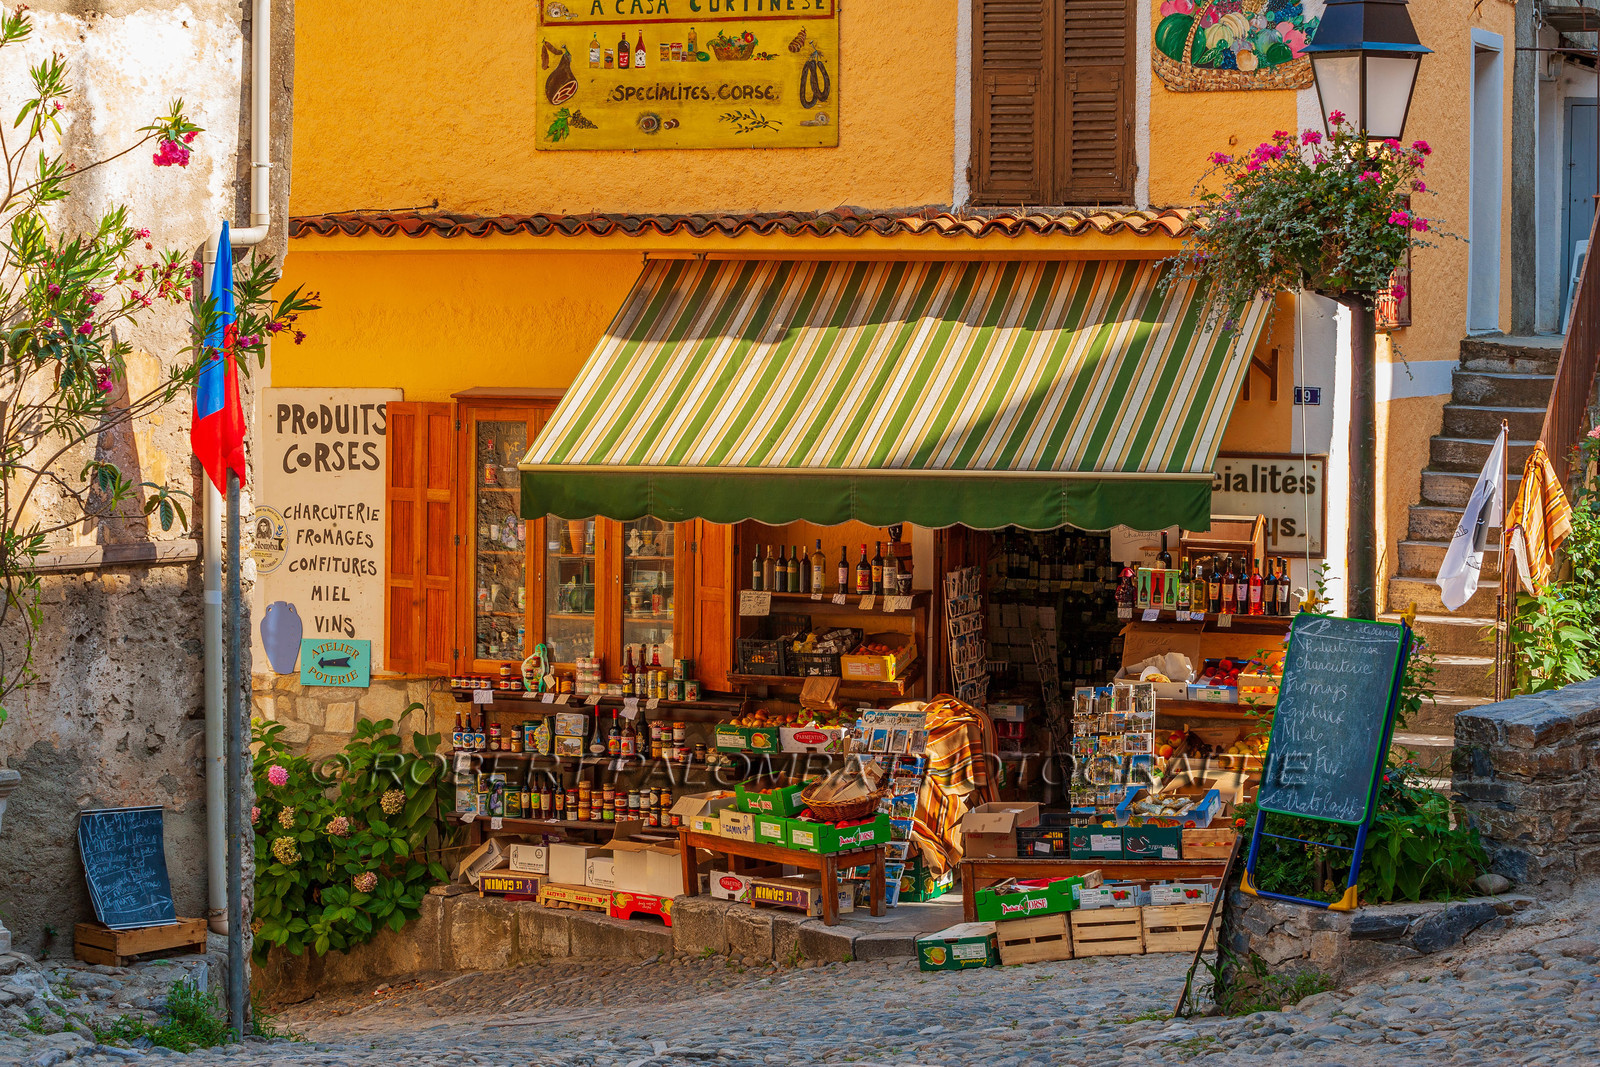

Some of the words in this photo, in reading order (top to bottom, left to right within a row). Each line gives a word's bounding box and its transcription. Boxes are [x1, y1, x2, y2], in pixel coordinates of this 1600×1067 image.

[1303, 390, 1311, 402] 9
[276, 403, 387, 436] PRODUITS
[282, 441, 381, 474] CORSES
[283, 502, 381, 523] CHARCUTERIE
[296, 528, 375, 549] FROMAGES
[288, 556, 378, 577] CONFITURES
[311, 585, 351, 602] MIEL
[314, 613, 356, 639] VINS
[311, 642, 360, 660] ATELIER
[307, 666, 359, 685] POTERIE
[796, 733, 826, 741] PARMENTINE
[725, 824, 742, 835] GAMIN
[484, 878, 515, 891] GAMIN
[755, 886, 785, 903] GAMIN
[1024, 897, 1048, 911] CORSE
